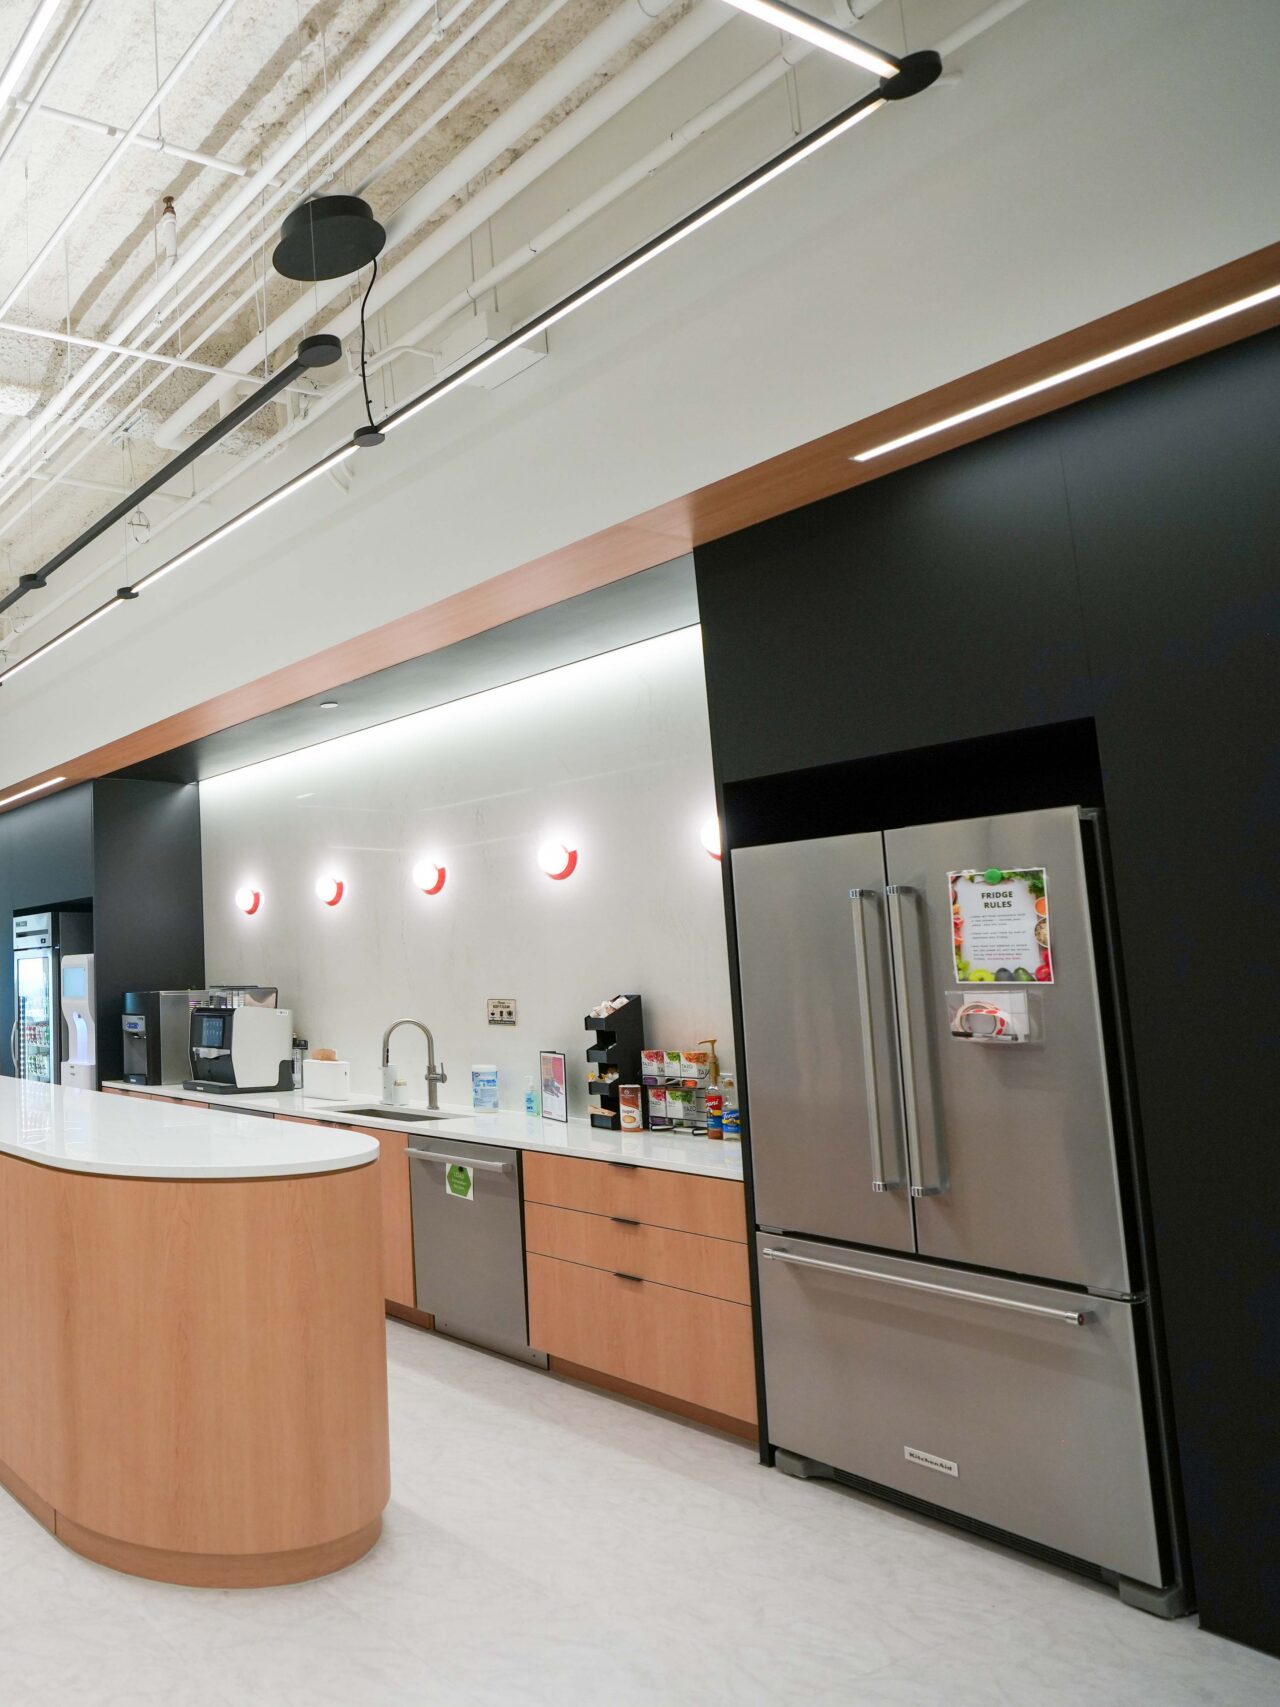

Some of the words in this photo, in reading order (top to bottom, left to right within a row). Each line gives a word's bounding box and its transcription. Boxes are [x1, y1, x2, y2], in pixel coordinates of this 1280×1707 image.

[981, 891, 1013, 899] FRIDGE
[984, 901, 1012, 909] RULES
[909, 1453, 952, 1471] KitchenAid
